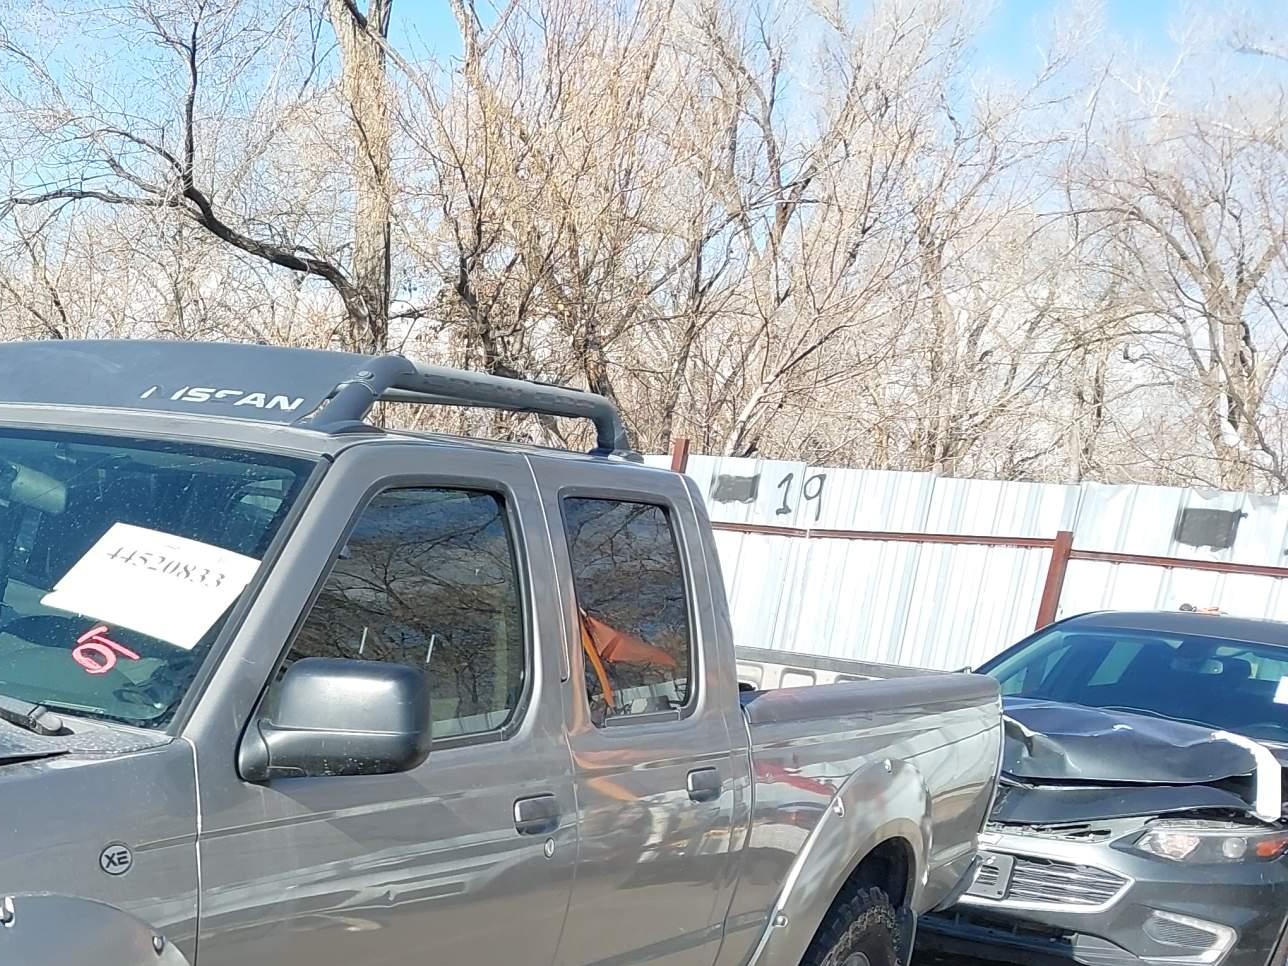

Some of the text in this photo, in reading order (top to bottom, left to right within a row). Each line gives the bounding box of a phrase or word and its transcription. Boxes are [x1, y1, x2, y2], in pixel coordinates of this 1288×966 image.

[776, 472, 827, 522] 19
[106, 546, 226, 588] 44520833
[104, 850, 129, 868] XE
